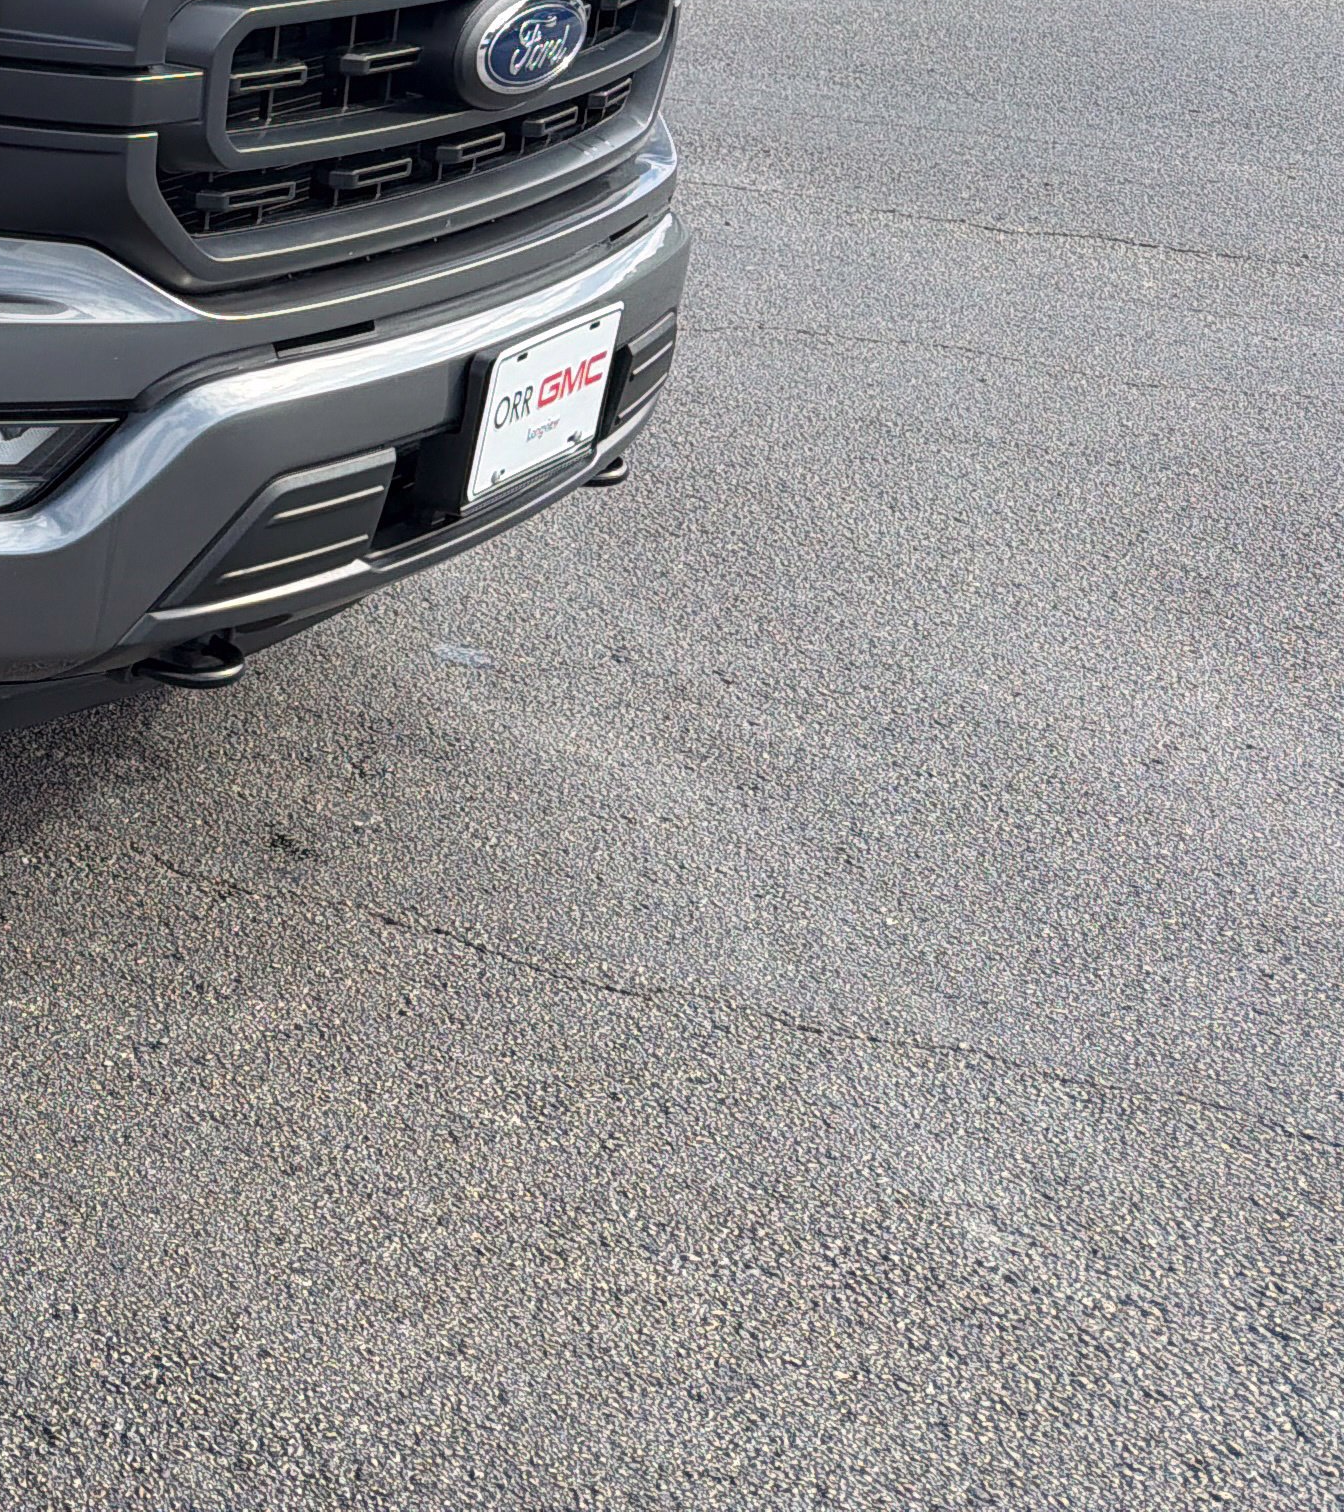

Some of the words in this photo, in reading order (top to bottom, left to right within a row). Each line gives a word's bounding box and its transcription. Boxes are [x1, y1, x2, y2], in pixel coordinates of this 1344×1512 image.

[509, 15, 572, 76] Ford
[493, 384, 534, 430] ORR
[537, 350, 608, 409] GMC
